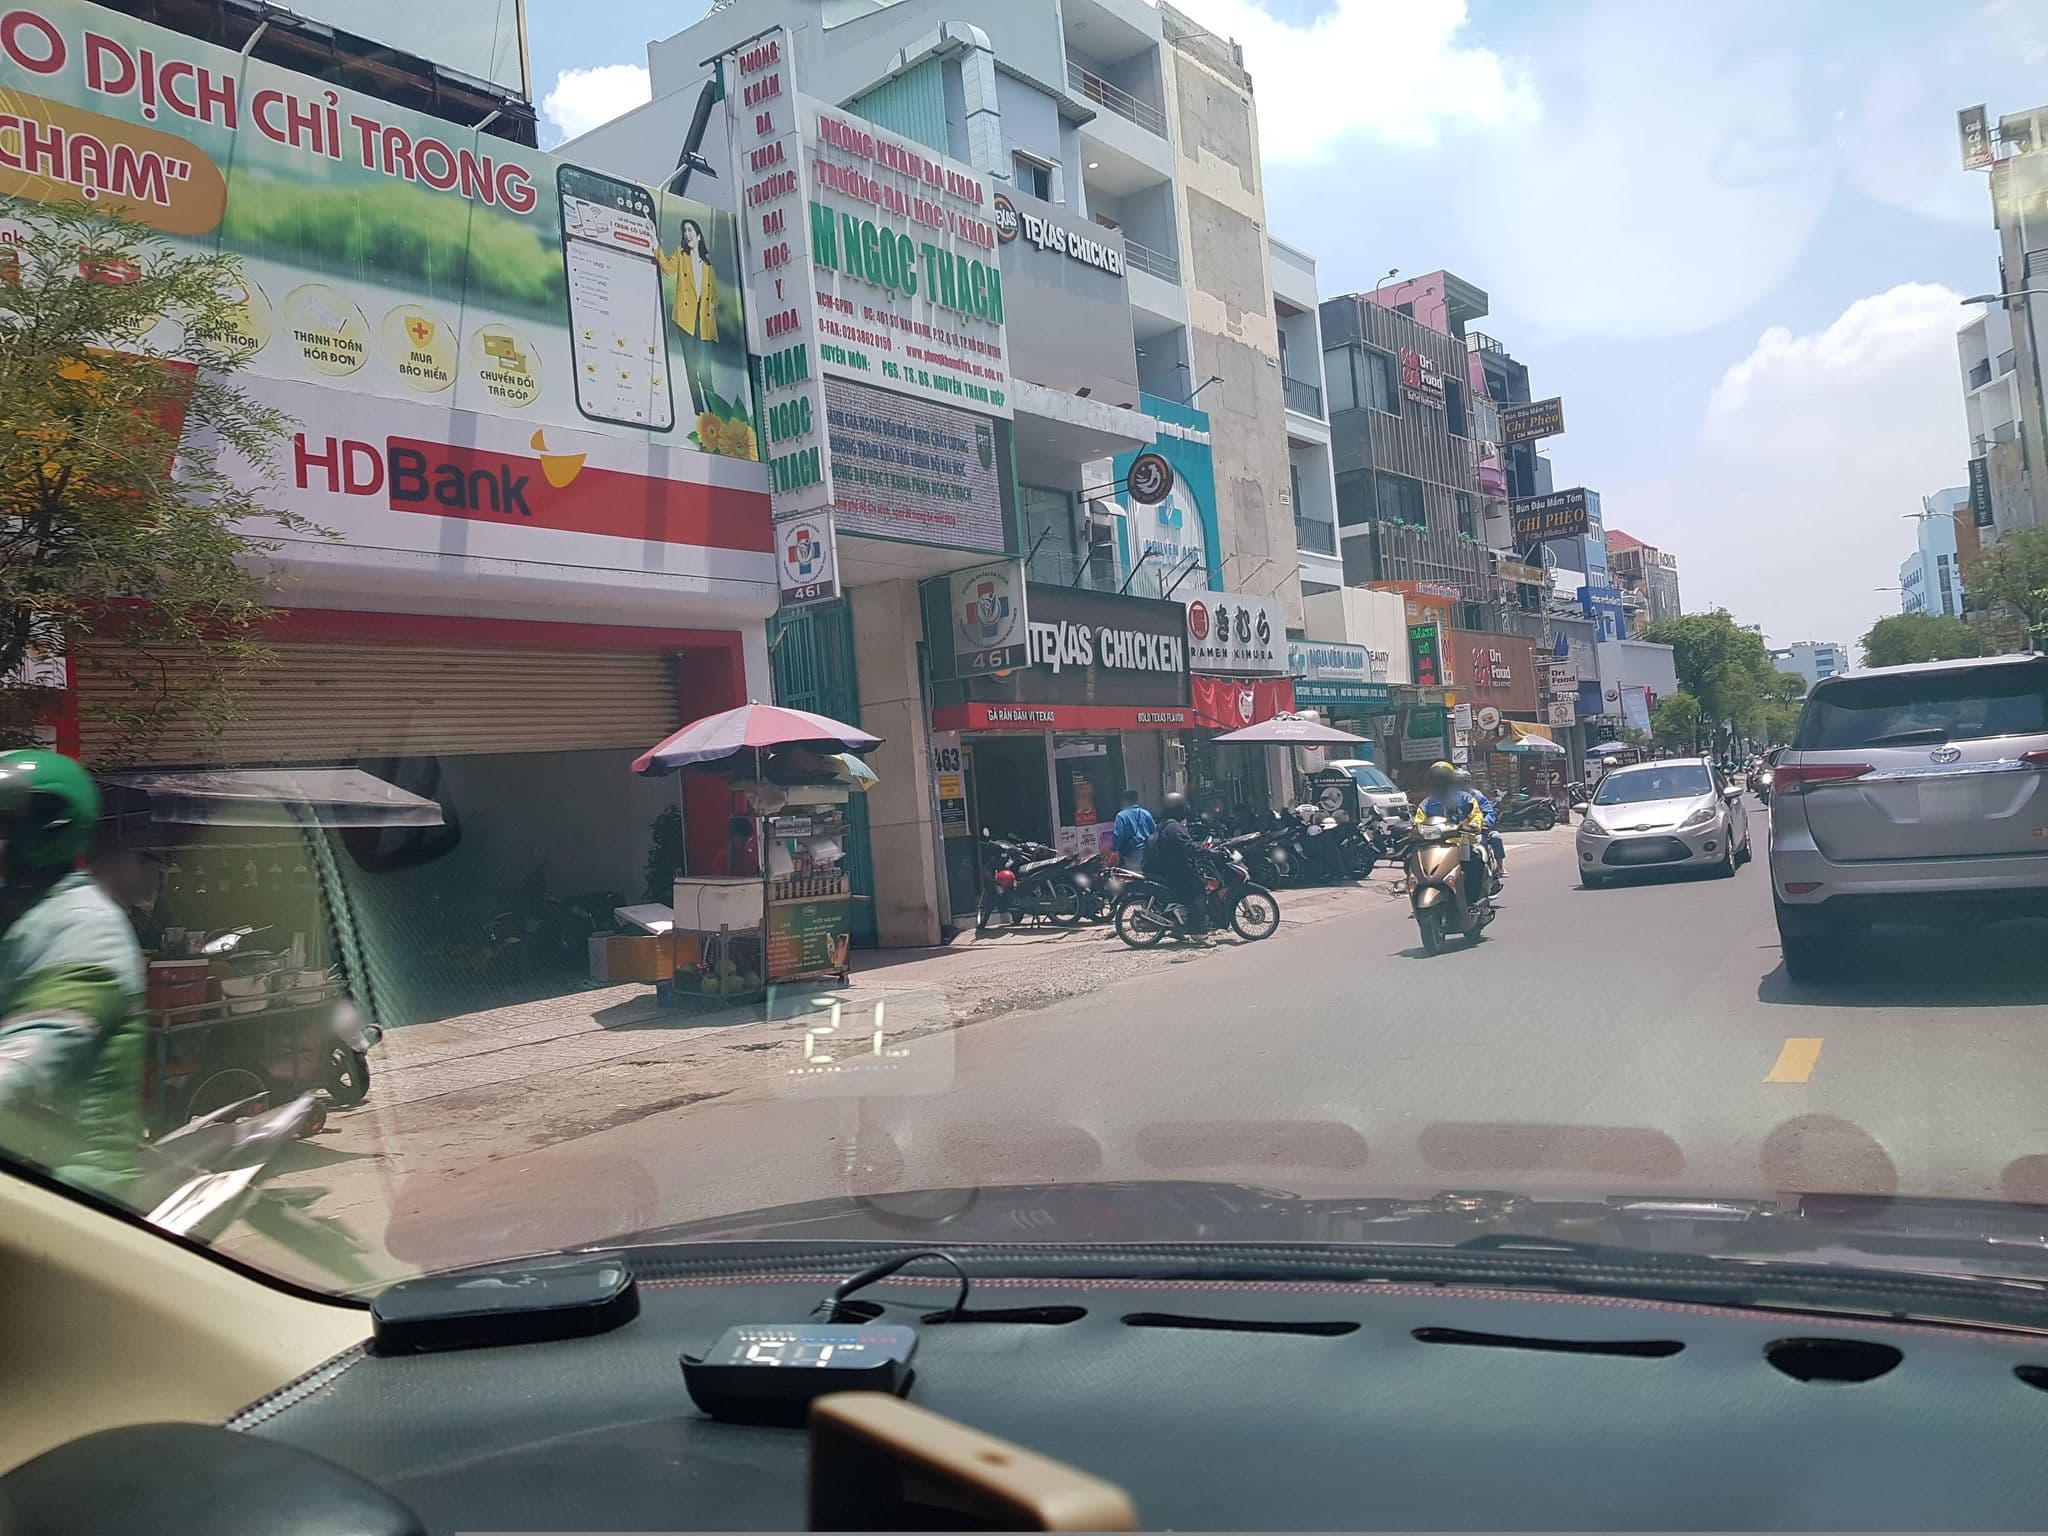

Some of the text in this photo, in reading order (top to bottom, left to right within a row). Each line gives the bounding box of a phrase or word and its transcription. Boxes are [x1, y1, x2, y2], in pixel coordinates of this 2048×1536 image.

[739, 40, 780, 76] PHÒNG
[743, 73, 780, 107] KHÁM
[85, 31, 238, 131] DỊCH
[251, 87, 341, 161] CHỈ
[350, 115, 538, 214] TRONG
[755, 110, 773, 135] ĐA
[750, 140, 784, 172] KHOA
[819, 115, 984, 205] PHÒNG KHÁM ĐA KHOA
[746, 169, 798, 207] TRƯỜNG
[815, 159, 995, 249] TRƯỜNG ĐẠI HỌC Y KHOA
[762, 208, 785, 237] ĐẠI
[1021, 212, 1125, 277] TEXAS CHICKEN
[763, 242, 791, 272] HỌC
[842, 212, 918, 302] NGỌC
[920, 241, 1004, 327] THẠCH
[775, 278, 784, 300] Y
[766, 308, 800, 339] KHOA
[876, 310, 889, 326] 461
[293, 330, 363, 353] THANH TOÁN
[842, 325, 856, 342] 028
[304, 347, 356, 367] HÓA ĐƠN
[410, 351, 433, 365] MUA
[763, 343, 809, 392] PHẠM
[399, 362, 448, 382] BẢO HIỂM
[480, 369, 535, 389] CHUYỂN ĐỔI
[848, 351, 871, 373] MÔN:
[882, 359, 902, 380] PGS.
[903, 365, 918, 385] TS.
[918, 369, 933, 389] BS.
[964, 382, 989, 404] THANH
[1420, 369, 1443, 392] Food
[488, 383, 529, 401] TRẢ GÓP
[769, 394, 814, 444] NGỌC
[293, 432, 532, 516] HDBank
[770, 446, 822, 496] THẠCH
[1515, 503, 1530, 514] Bún
[1545, 506, 1585, 528] PHÈO
[794, 584, 821, 600] 461
[1215, 602, 1271, 646] きむら
[971, 648, 1011, 669] 461
[1028, 620, 1094, 674] TEXAS
[1099, 626, 1184, 673] CHICKEN
[1190, 646, 1274, 660] RAMEN KIMURA
[1370, 650, 1390, 662] EAUTY
[1491, 664, 1511, 679] Food
[1552, 675, 1576, 684] Food
[988, 706, 1056, 725] GÀ RÁN ĐẬM VỊ TEXAS
[1137, 712, 1185, 723] BOLD TEXAS FLAVOR
[934, 748, 960, 772] 463
